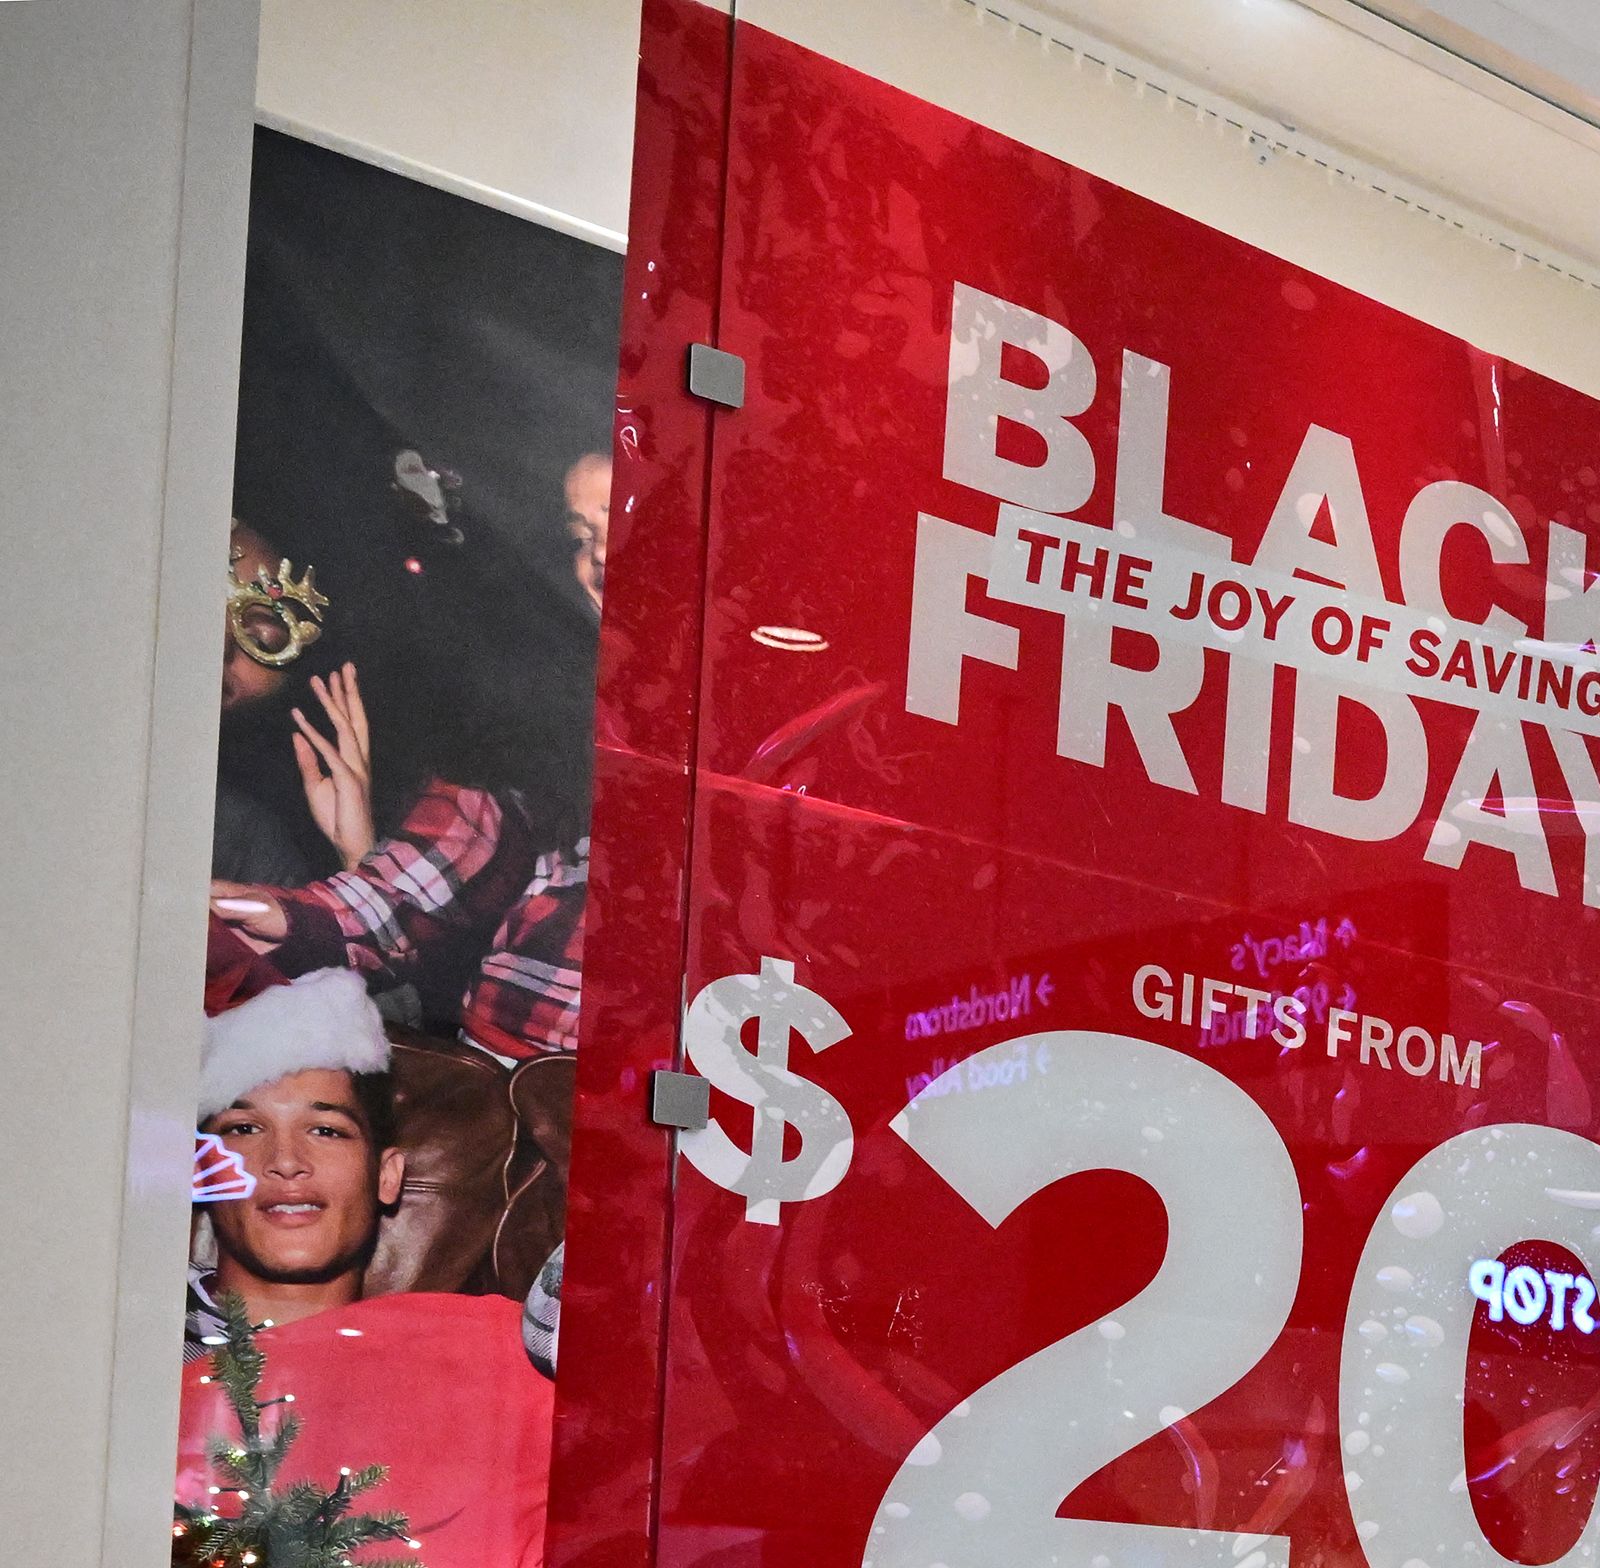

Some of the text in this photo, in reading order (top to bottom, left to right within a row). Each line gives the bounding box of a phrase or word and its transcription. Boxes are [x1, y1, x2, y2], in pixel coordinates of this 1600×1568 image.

[1017, 528, 1155, 612] THE
[1169, 572, 1297, 642] JOY
[1310, 607, 1392, 662] OF
[1132, 964, 1483, 1089] GIFTS FROM
